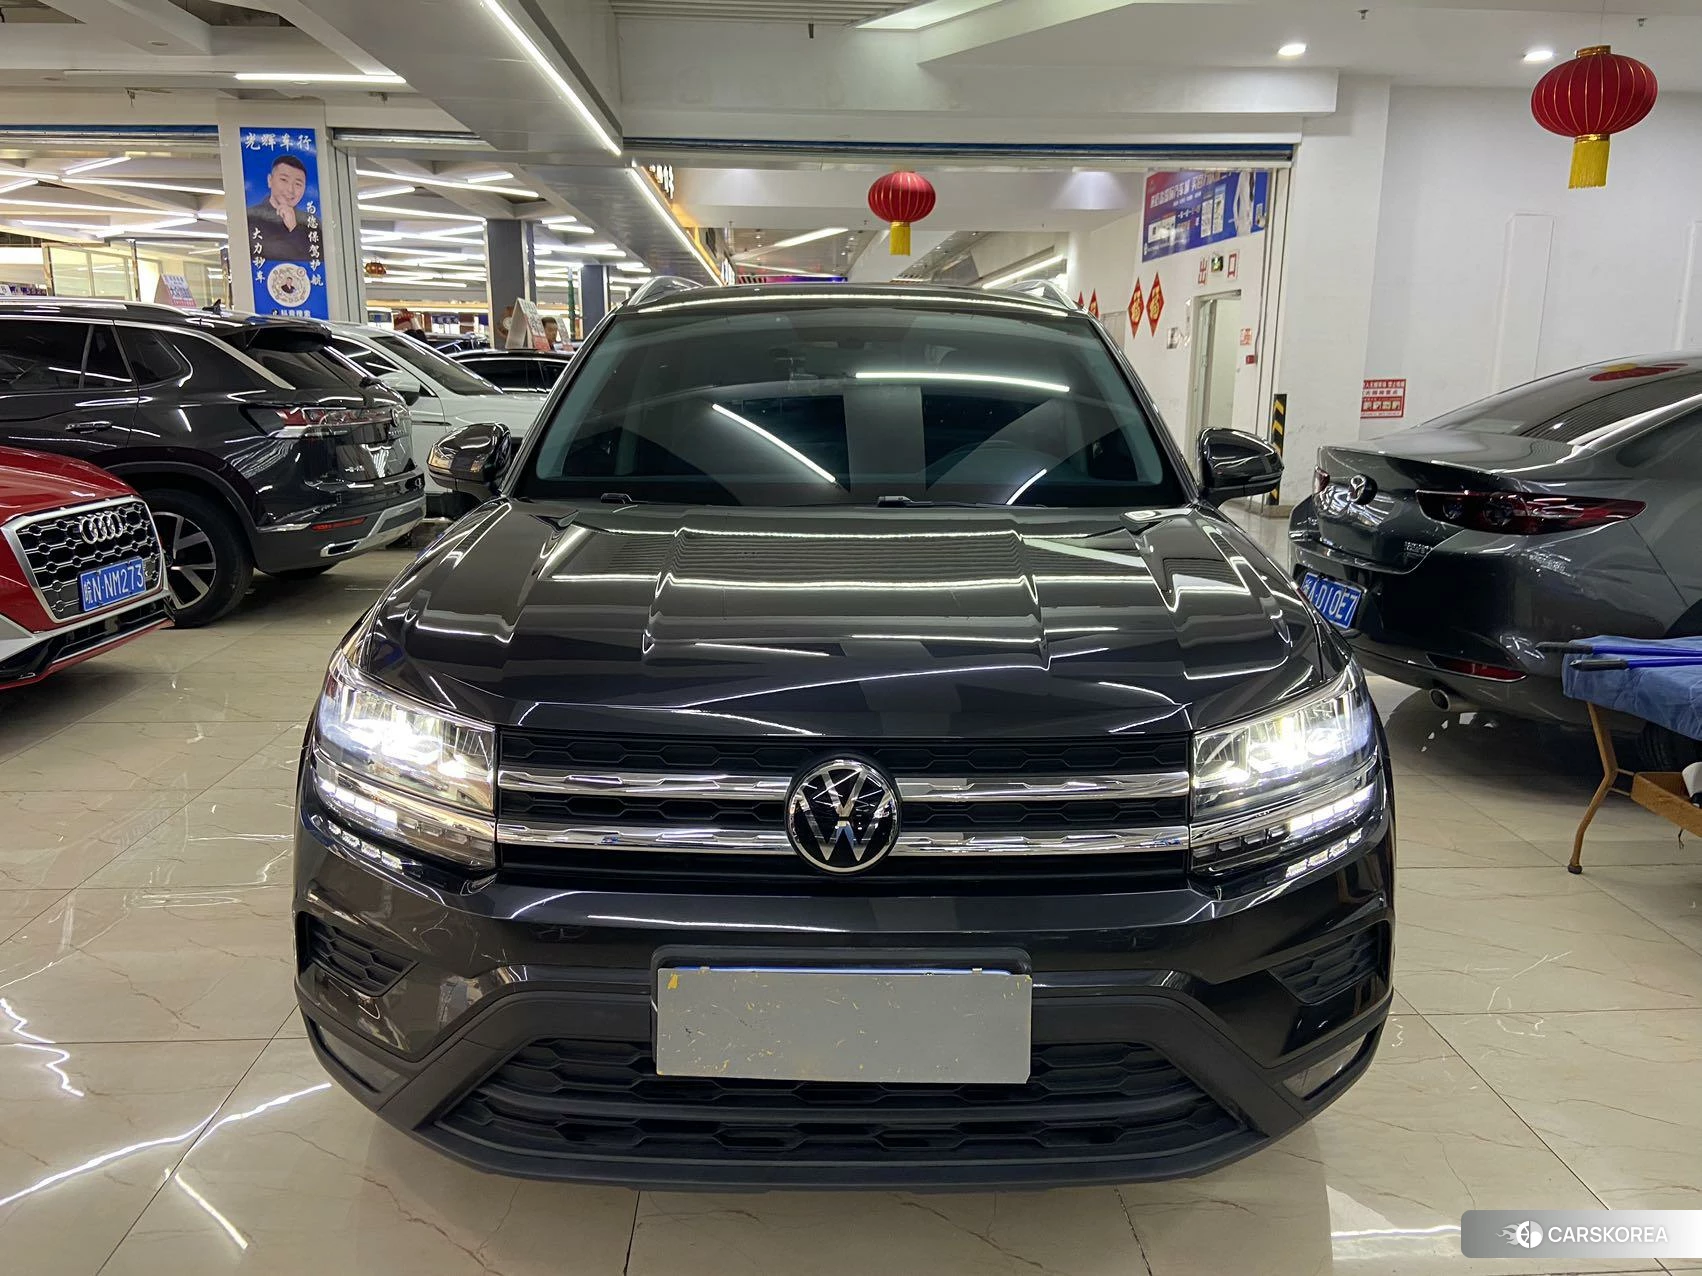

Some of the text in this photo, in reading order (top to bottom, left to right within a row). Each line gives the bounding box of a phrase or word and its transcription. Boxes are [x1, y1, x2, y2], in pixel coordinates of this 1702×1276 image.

[306, 201, 324, 287] 为您保驾护航
